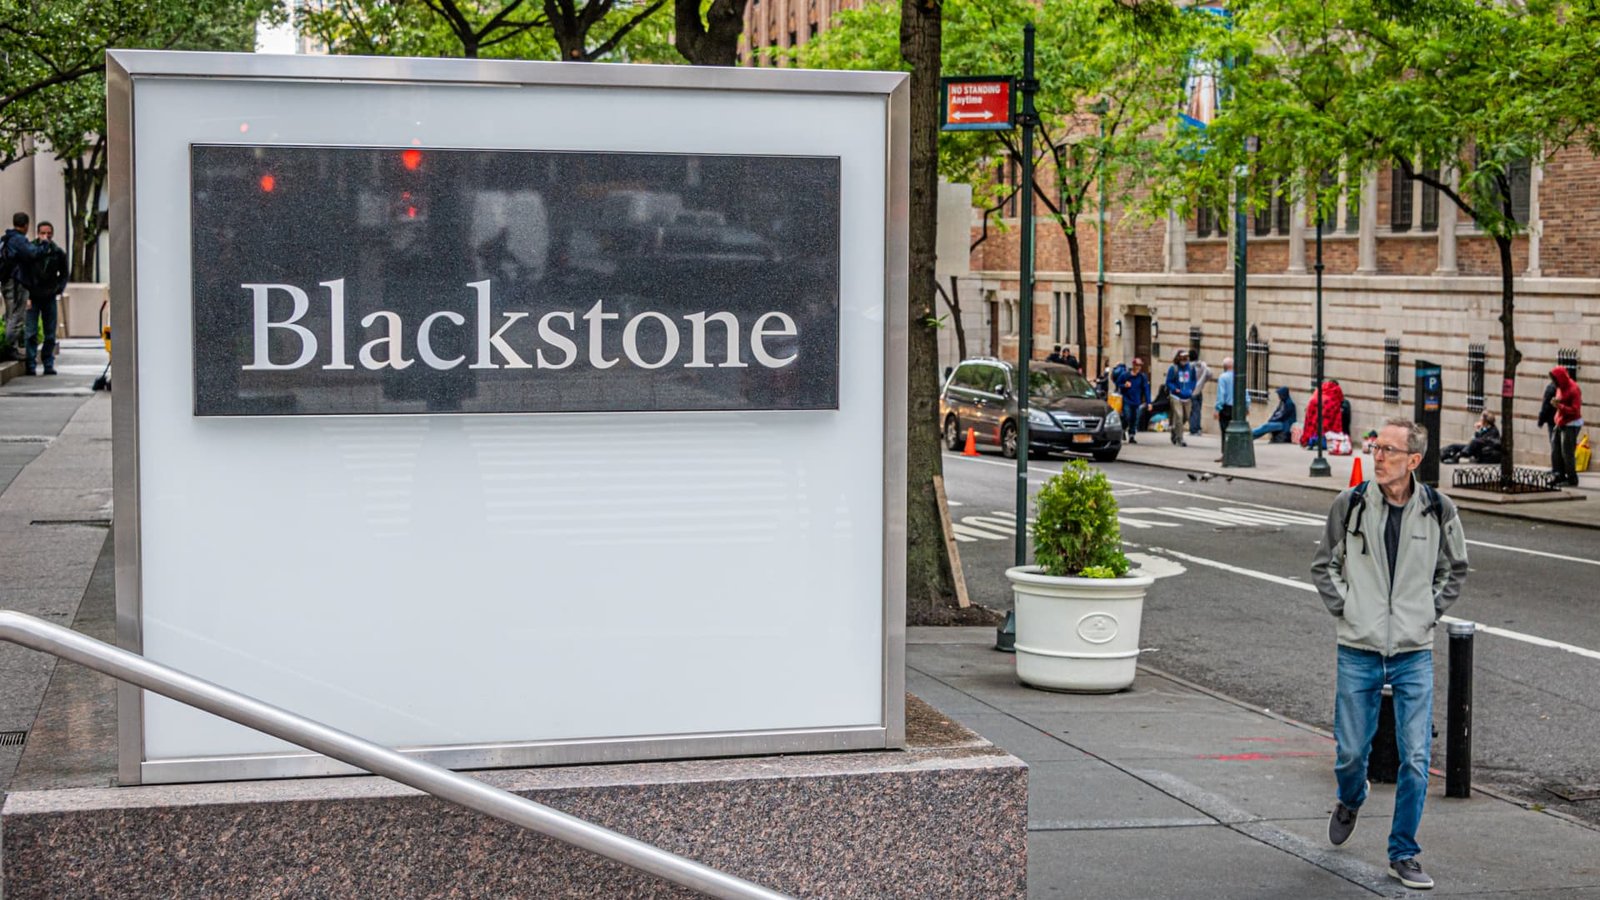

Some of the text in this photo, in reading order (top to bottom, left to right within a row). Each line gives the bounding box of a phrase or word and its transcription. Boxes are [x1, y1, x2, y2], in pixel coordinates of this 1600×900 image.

[952, 85, 1001, 95] NO STANDING
[951, 96, 983, 106] Anytime
[241, 279, 798, 370] Blackstone
[1429, 376, 1437, 390] P
